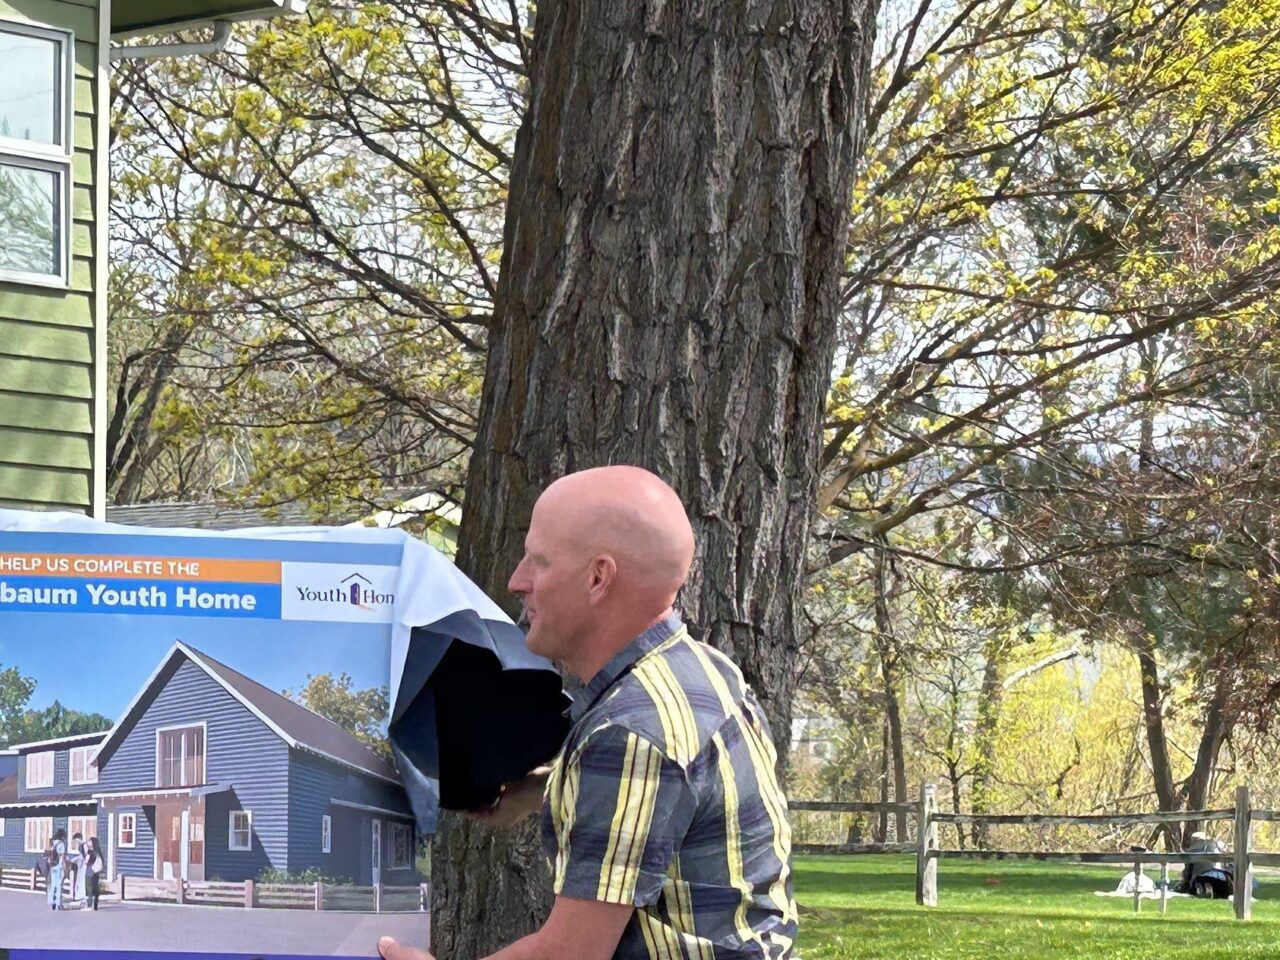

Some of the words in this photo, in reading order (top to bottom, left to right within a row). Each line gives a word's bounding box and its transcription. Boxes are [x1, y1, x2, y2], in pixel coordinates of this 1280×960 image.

[0, 556, 42, 571] HELP
[46, 558, 70, 572] US
[73, 559, 163, 575] COMPLETE
[167, 561, 200, 577] THE
[85, 583, 167, 608] Youth
[176, 586, 257, 611] Home
[296, 586, 347, 603] Youth
